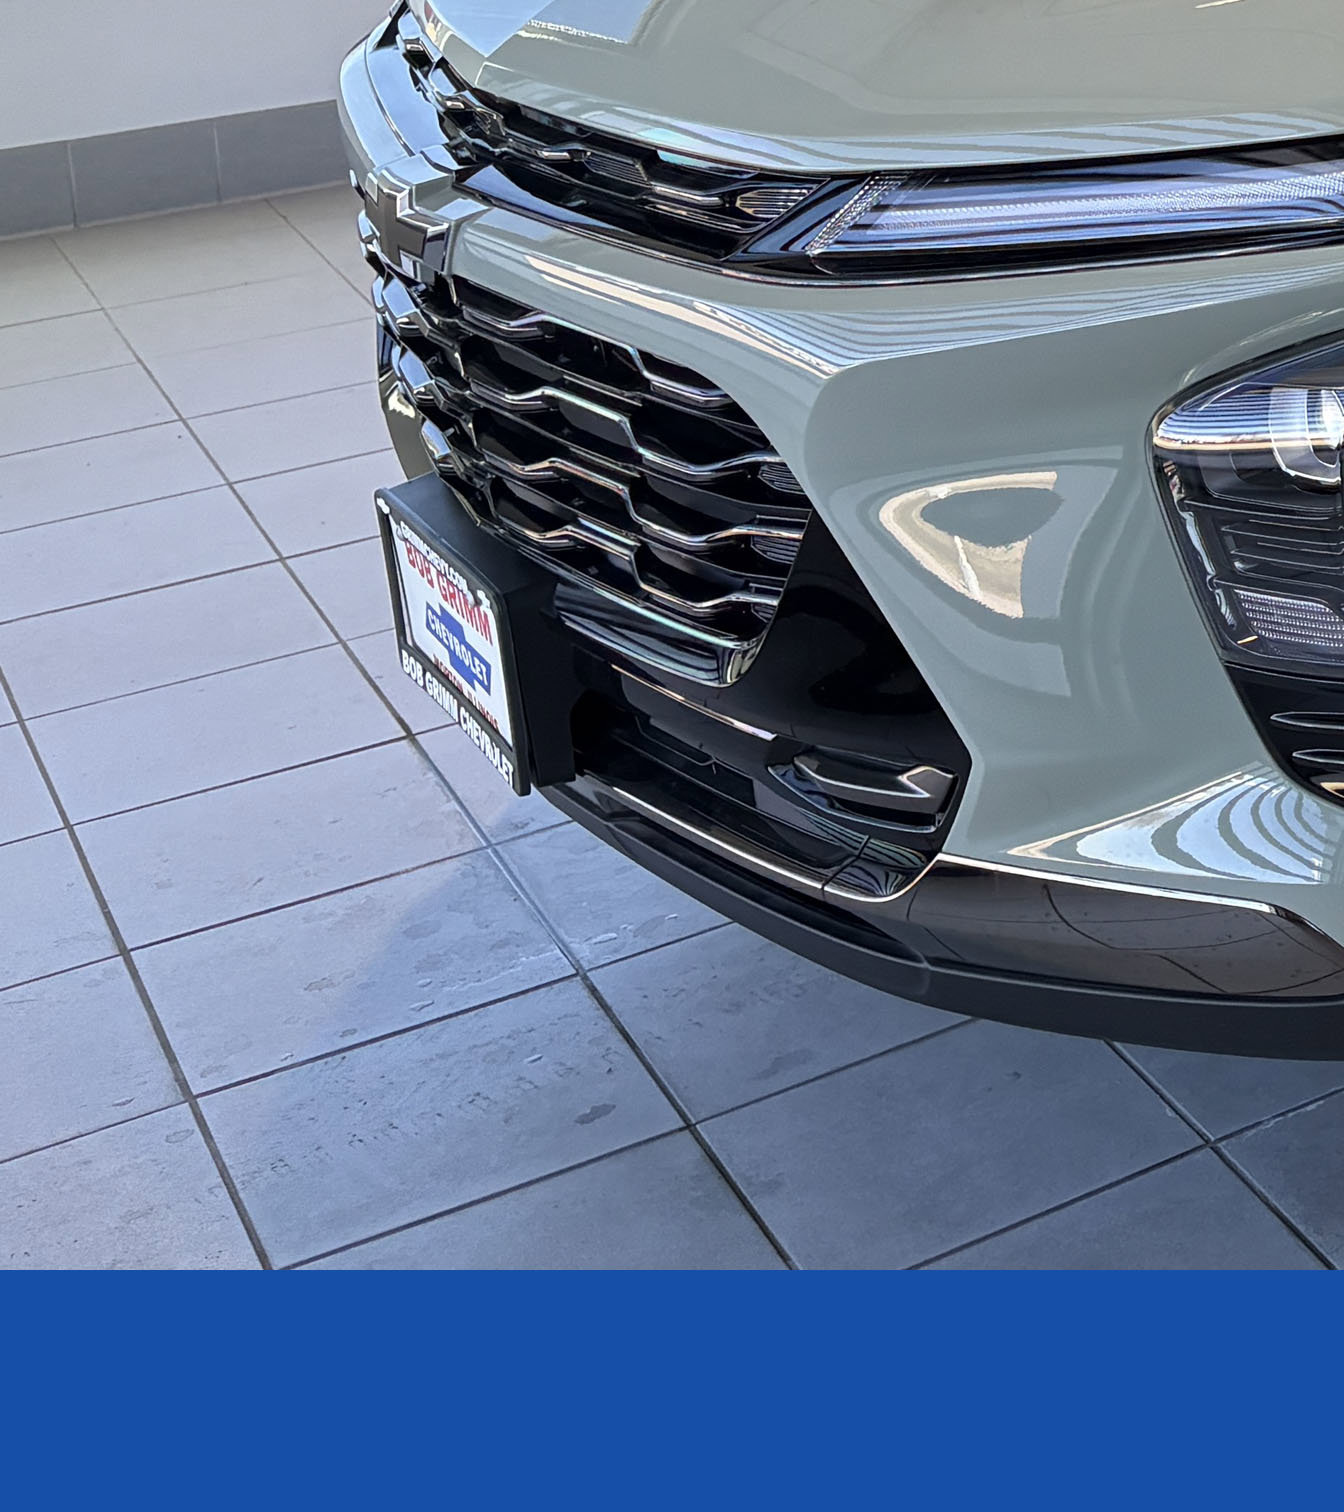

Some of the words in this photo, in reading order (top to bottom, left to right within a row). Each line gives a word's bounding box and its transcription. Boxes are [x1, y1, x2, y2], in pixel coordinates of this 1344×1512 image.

[404, 540, 435, 589] BOB
[436, 570, 493, 646] GRIMM
[426, 608, 488, 687] CHEVROLET
[401, 651, 425, 688] BOB
[425, 671, 459, 723] GRIMM
[459, 706, 514, 789] CHEVROLET
